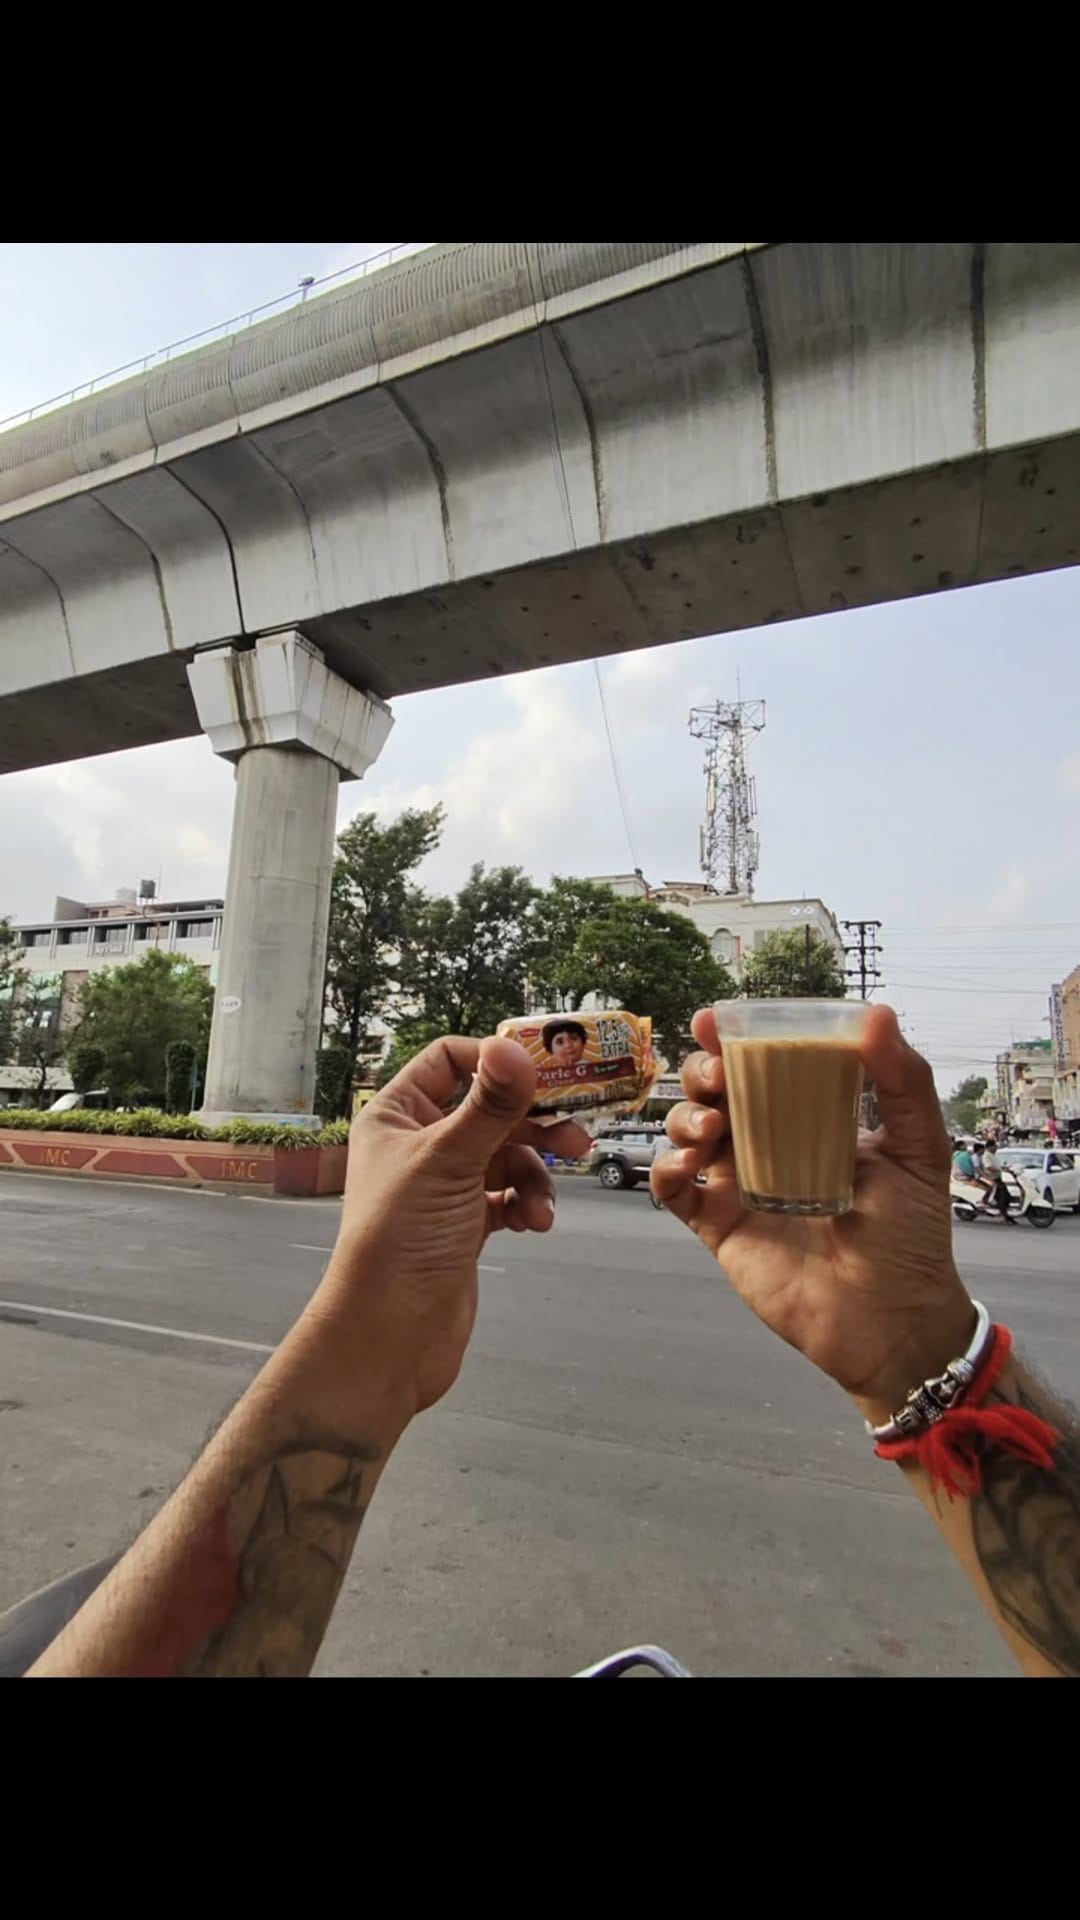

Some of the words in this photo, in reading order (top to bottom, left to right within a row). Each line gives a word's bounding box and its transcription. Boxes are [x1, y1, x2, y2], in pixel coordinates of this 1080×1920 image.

[601, 1040, 630, 1058] EXTRA
[40, 1148, 70, 1166] IMC
[221, 1160, 258, 1180] IMC
